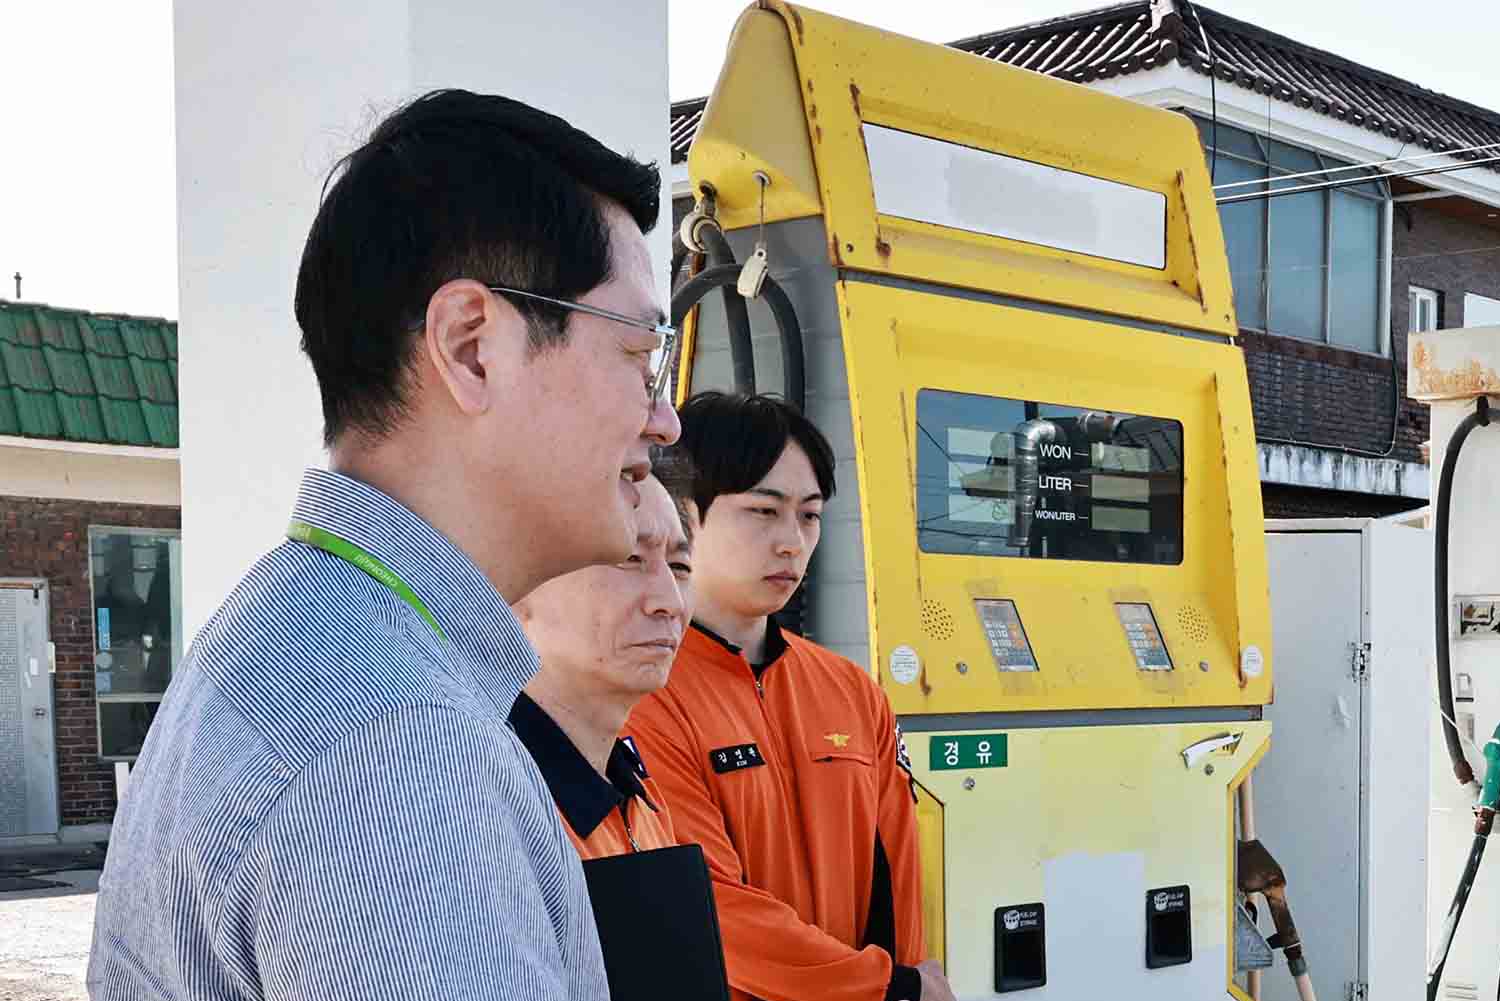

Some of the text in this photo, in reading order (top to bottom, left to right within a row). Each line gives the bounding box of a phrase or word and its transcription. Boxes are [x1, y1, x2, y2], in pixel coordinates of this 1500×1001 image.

[1040, 443, 1071, 460] WON
[1039, 475, 1072, 491] LITER
[1035, 510, 1076, 521] WON/LITER
